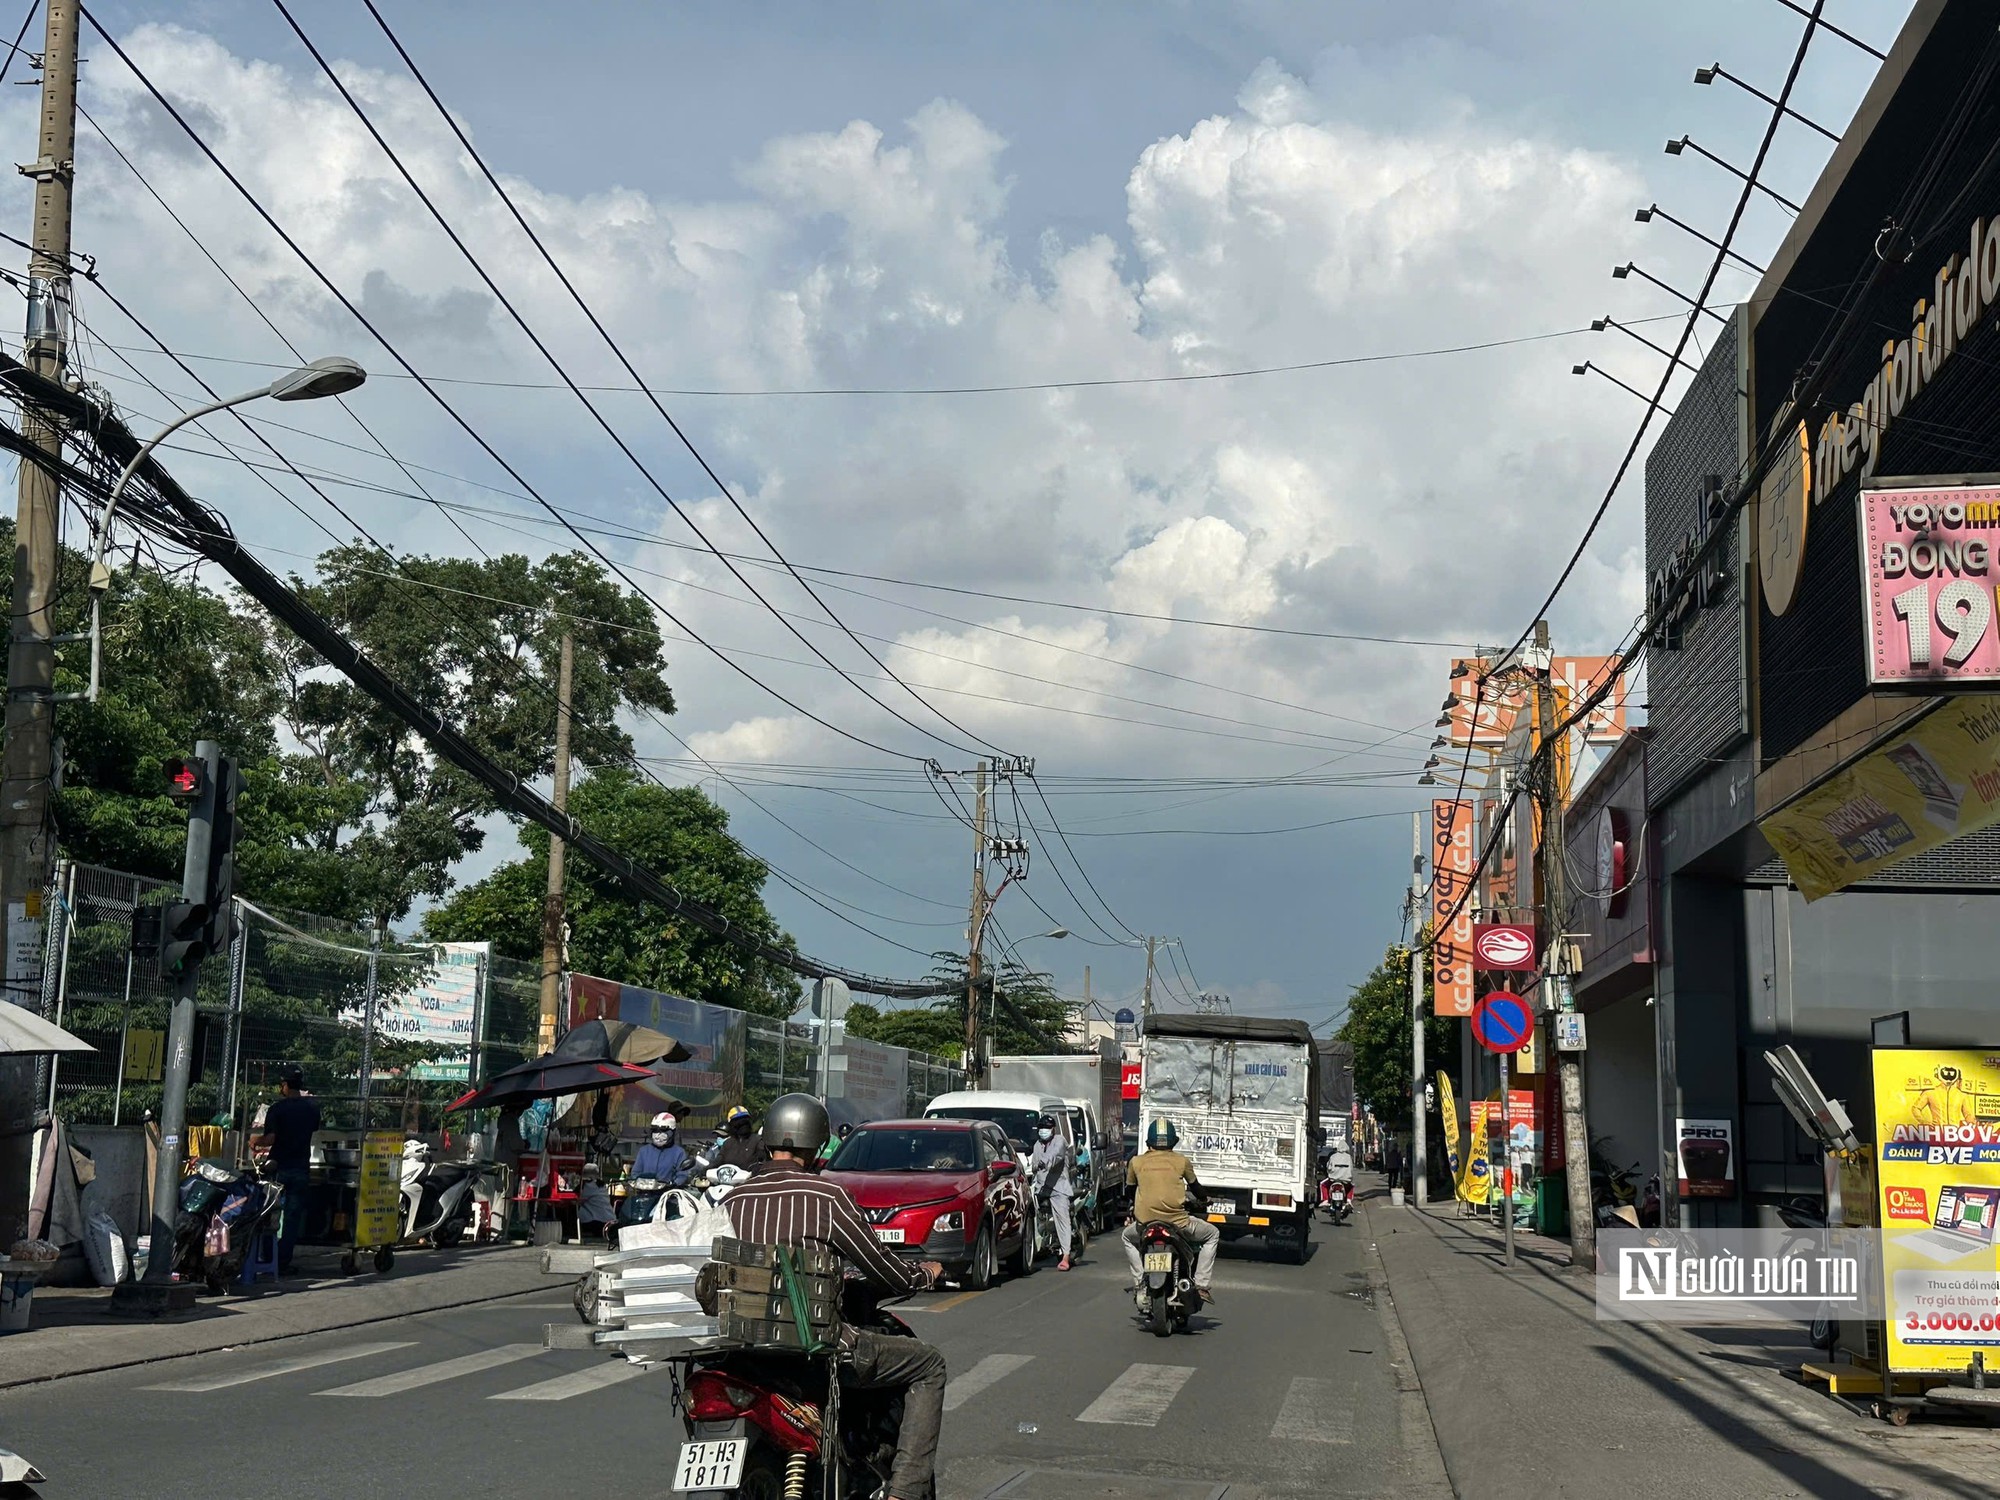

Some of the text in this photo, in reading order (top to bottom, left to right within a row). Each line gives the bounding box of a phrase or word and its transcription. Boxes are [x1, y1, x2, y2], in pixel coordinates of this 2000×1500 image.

[1881, 526, 1989, 579] ĐỒNG
[1892, 580, 2000, 668] 19
[419, 997, 440, 1010] YOGA
[1681, 1128, 1727, 1138] PRO
[1893, 1121, 2000, 1143] ANH BỜ V-
[1888, 1145, 1923, 1158] ĐÁNH
[1927, 1146, 1973, 1164] BYE
[1927, 1280, 1947, 1290] Thu
[1948, 1280, 1961, 1290] cũ
[1963, 1278, 1979, 1290] đổi
[1915, 1295, 1935, 1307] Trợ
[1936, 1294, 1956, 1308] giá
[1957, 1295, 1989, 1306] thêm
[687, 1442, 737, 1465] 51-H3
[684, 1464, 731, 1488] 1811
